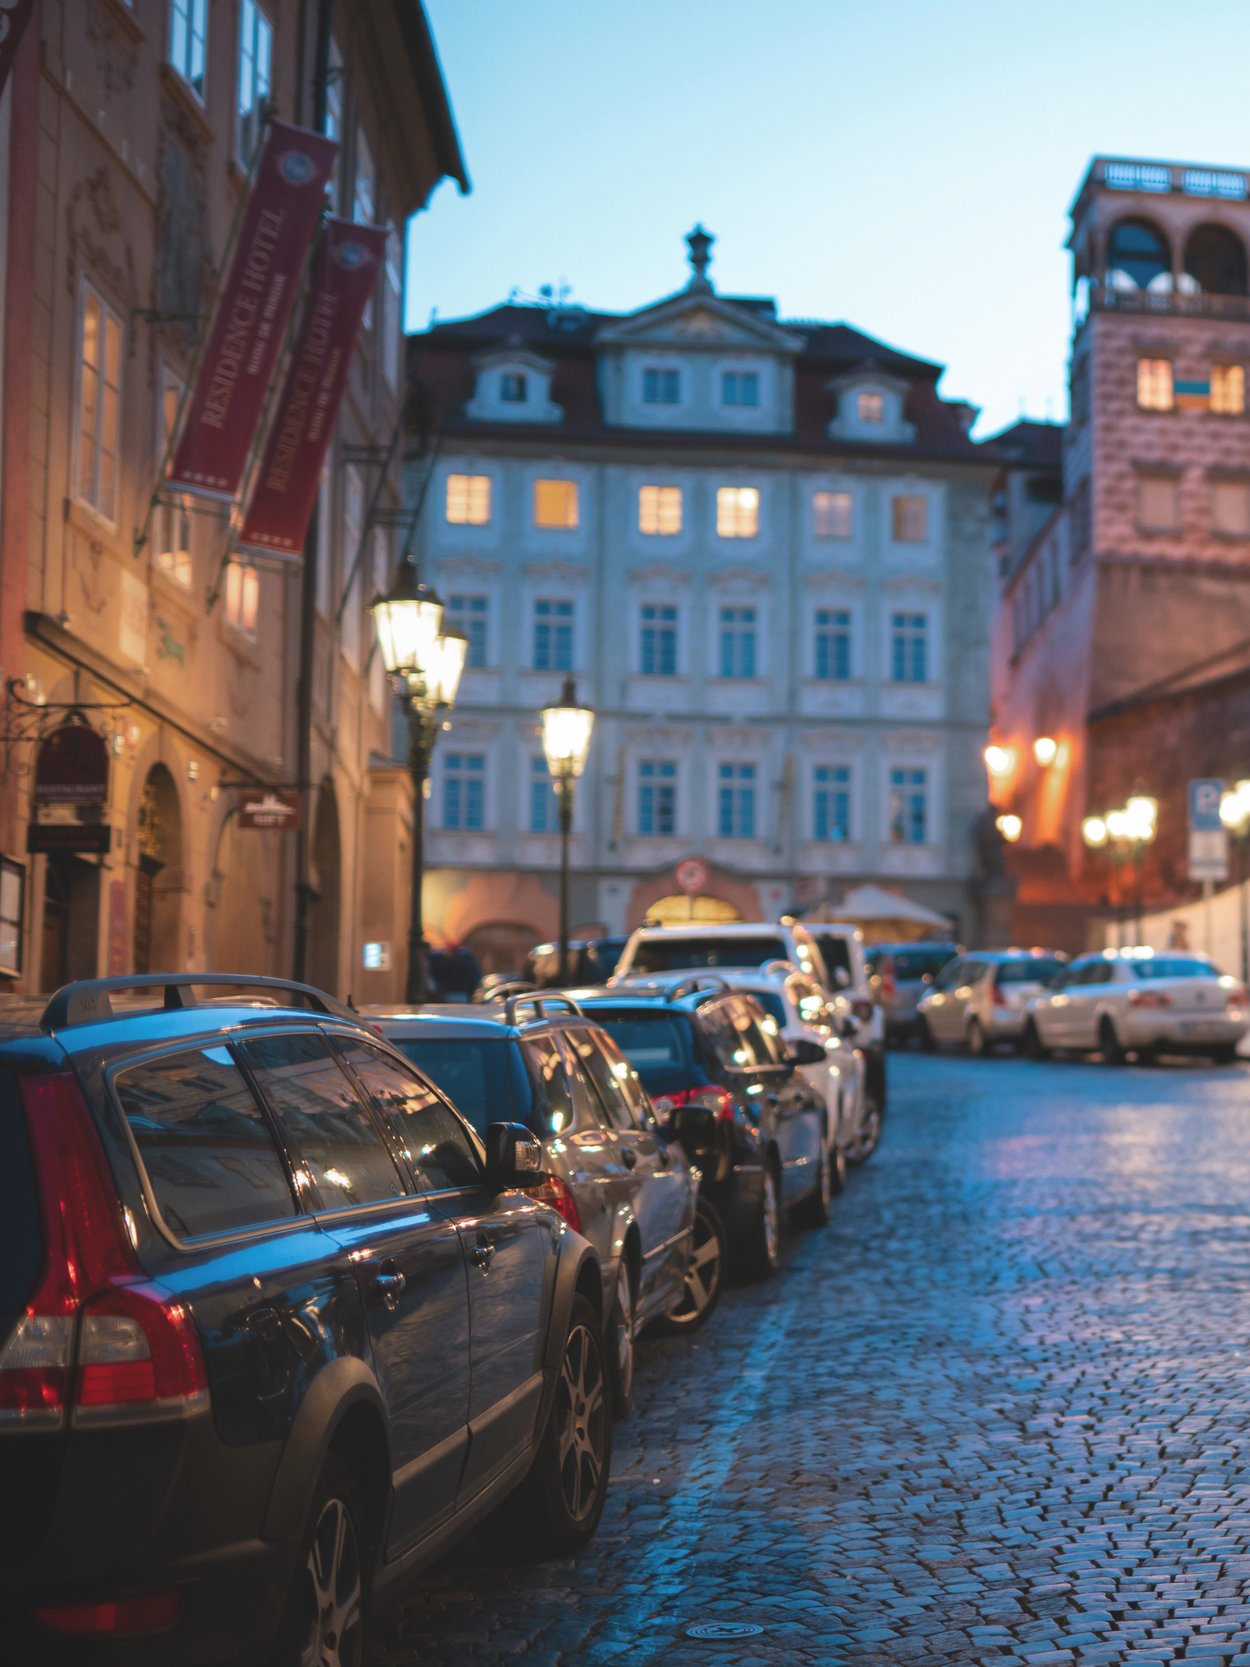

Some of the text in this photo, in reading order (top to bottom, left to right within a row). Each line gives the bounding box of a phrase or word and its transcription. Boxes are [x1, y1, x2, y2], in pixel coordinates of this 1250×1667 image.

[201, 207, 286, 430] RESIDENCE HOTEL
[267, 289, 340, 492] RESIDENCE HOTEL
